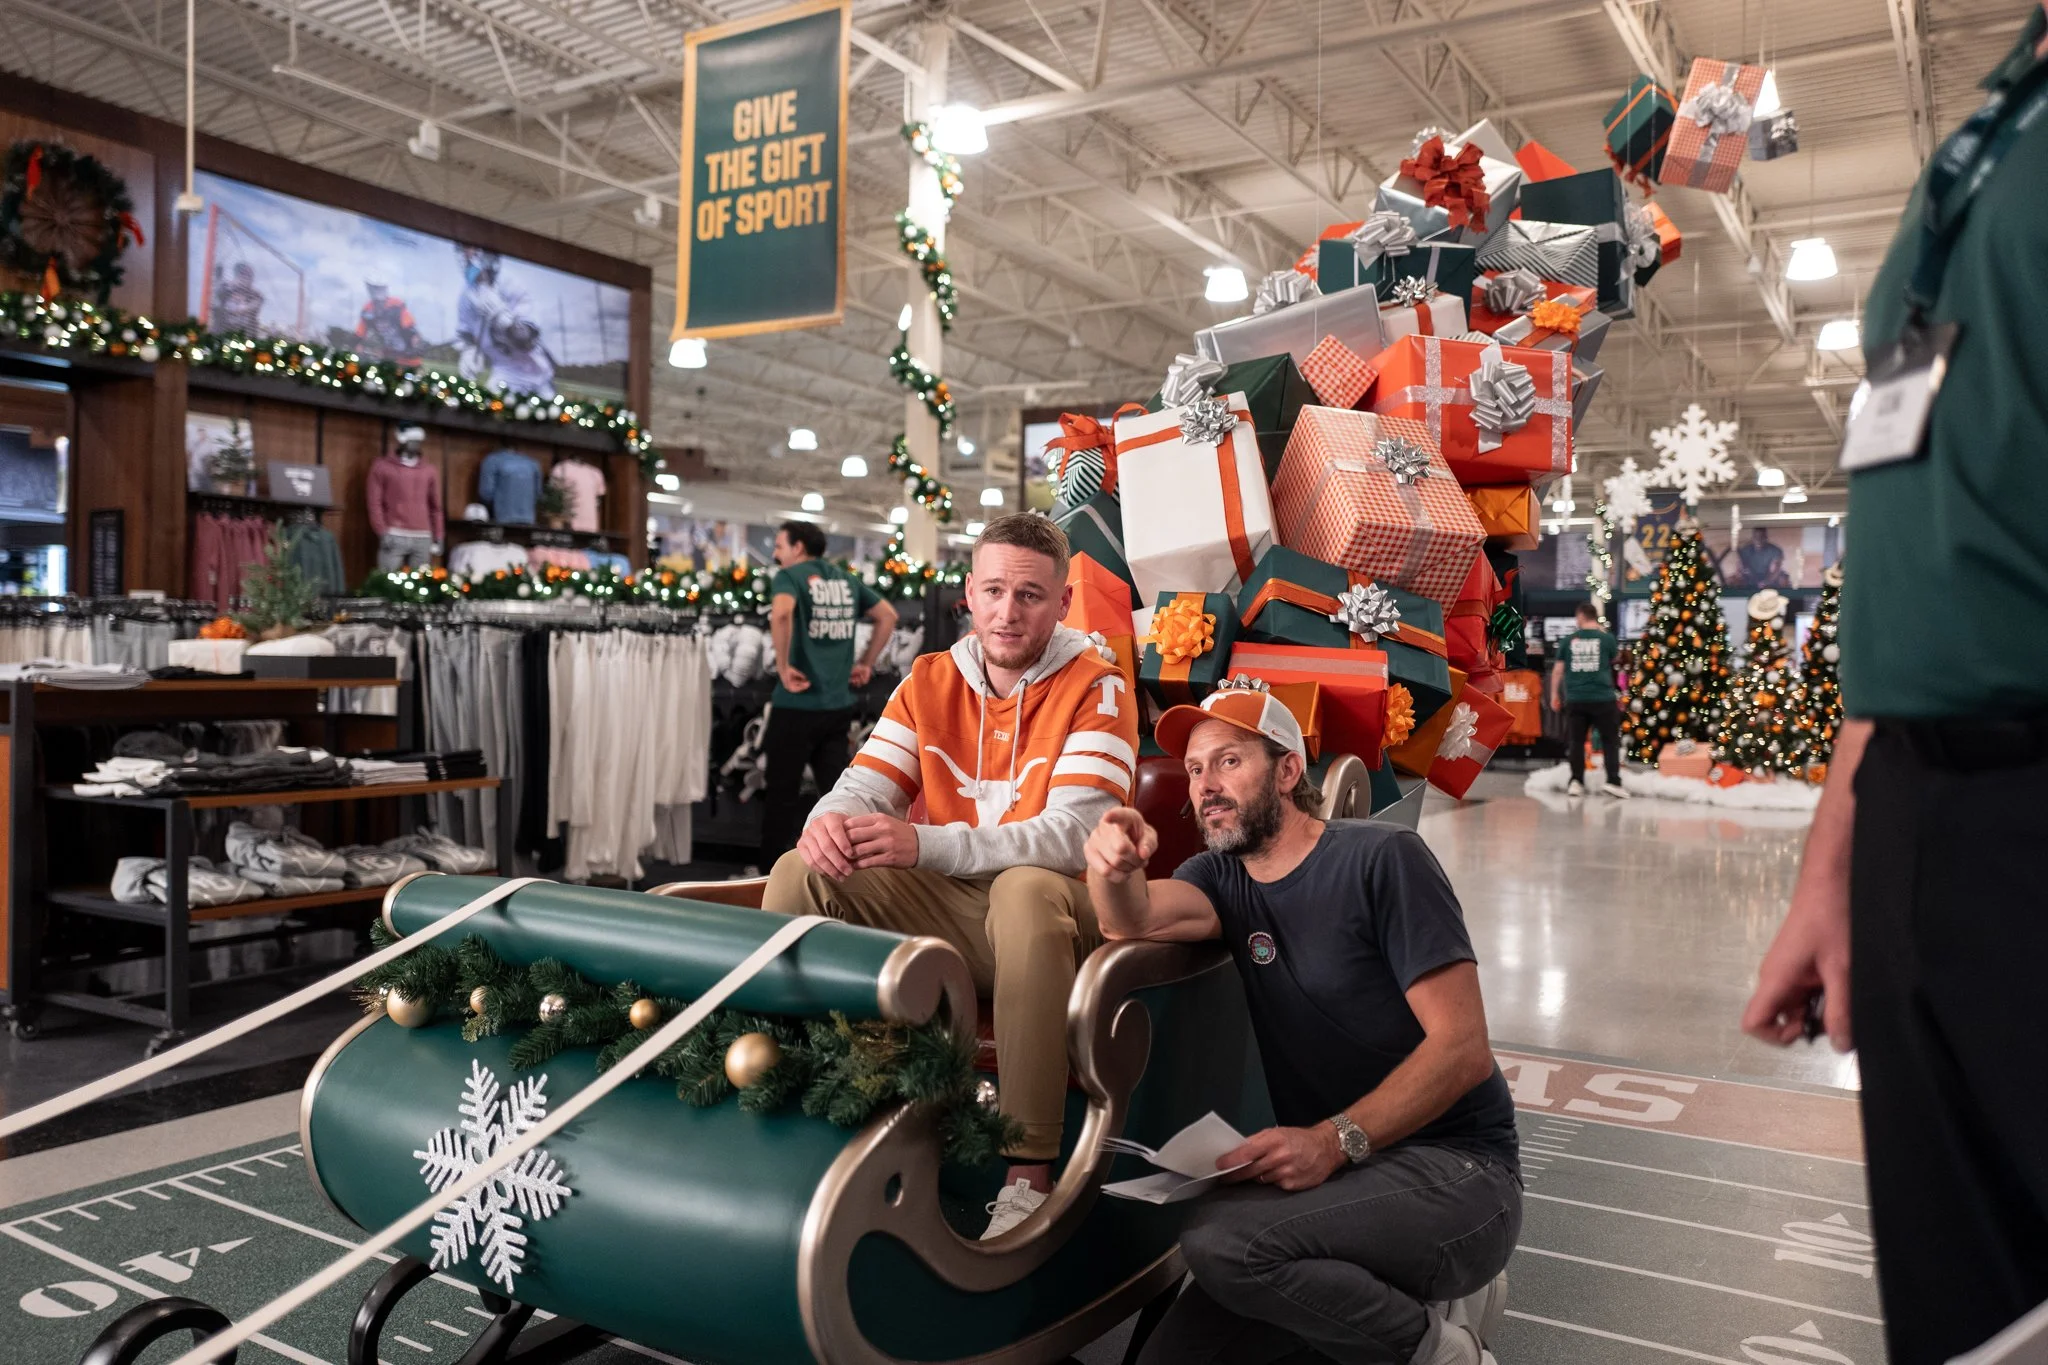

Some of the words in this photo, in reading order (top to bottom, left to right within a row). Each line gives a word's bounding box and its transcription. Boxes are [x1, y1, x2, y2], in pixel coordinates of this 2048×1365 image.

[733, 89, 798, 142] GIVE
[705, 144, 757, 194] THE
[761, 132, 826, 184] GIFT
[697, 196, 732, 242] OF
[735, 180, 832, 236] SPORT
[1641, 523, 1670, 549] 22
[809, 578, 853, 605] GIVE
[808, 620, 855, 640] SPORT
[1090, 674, 1126, 718] T
